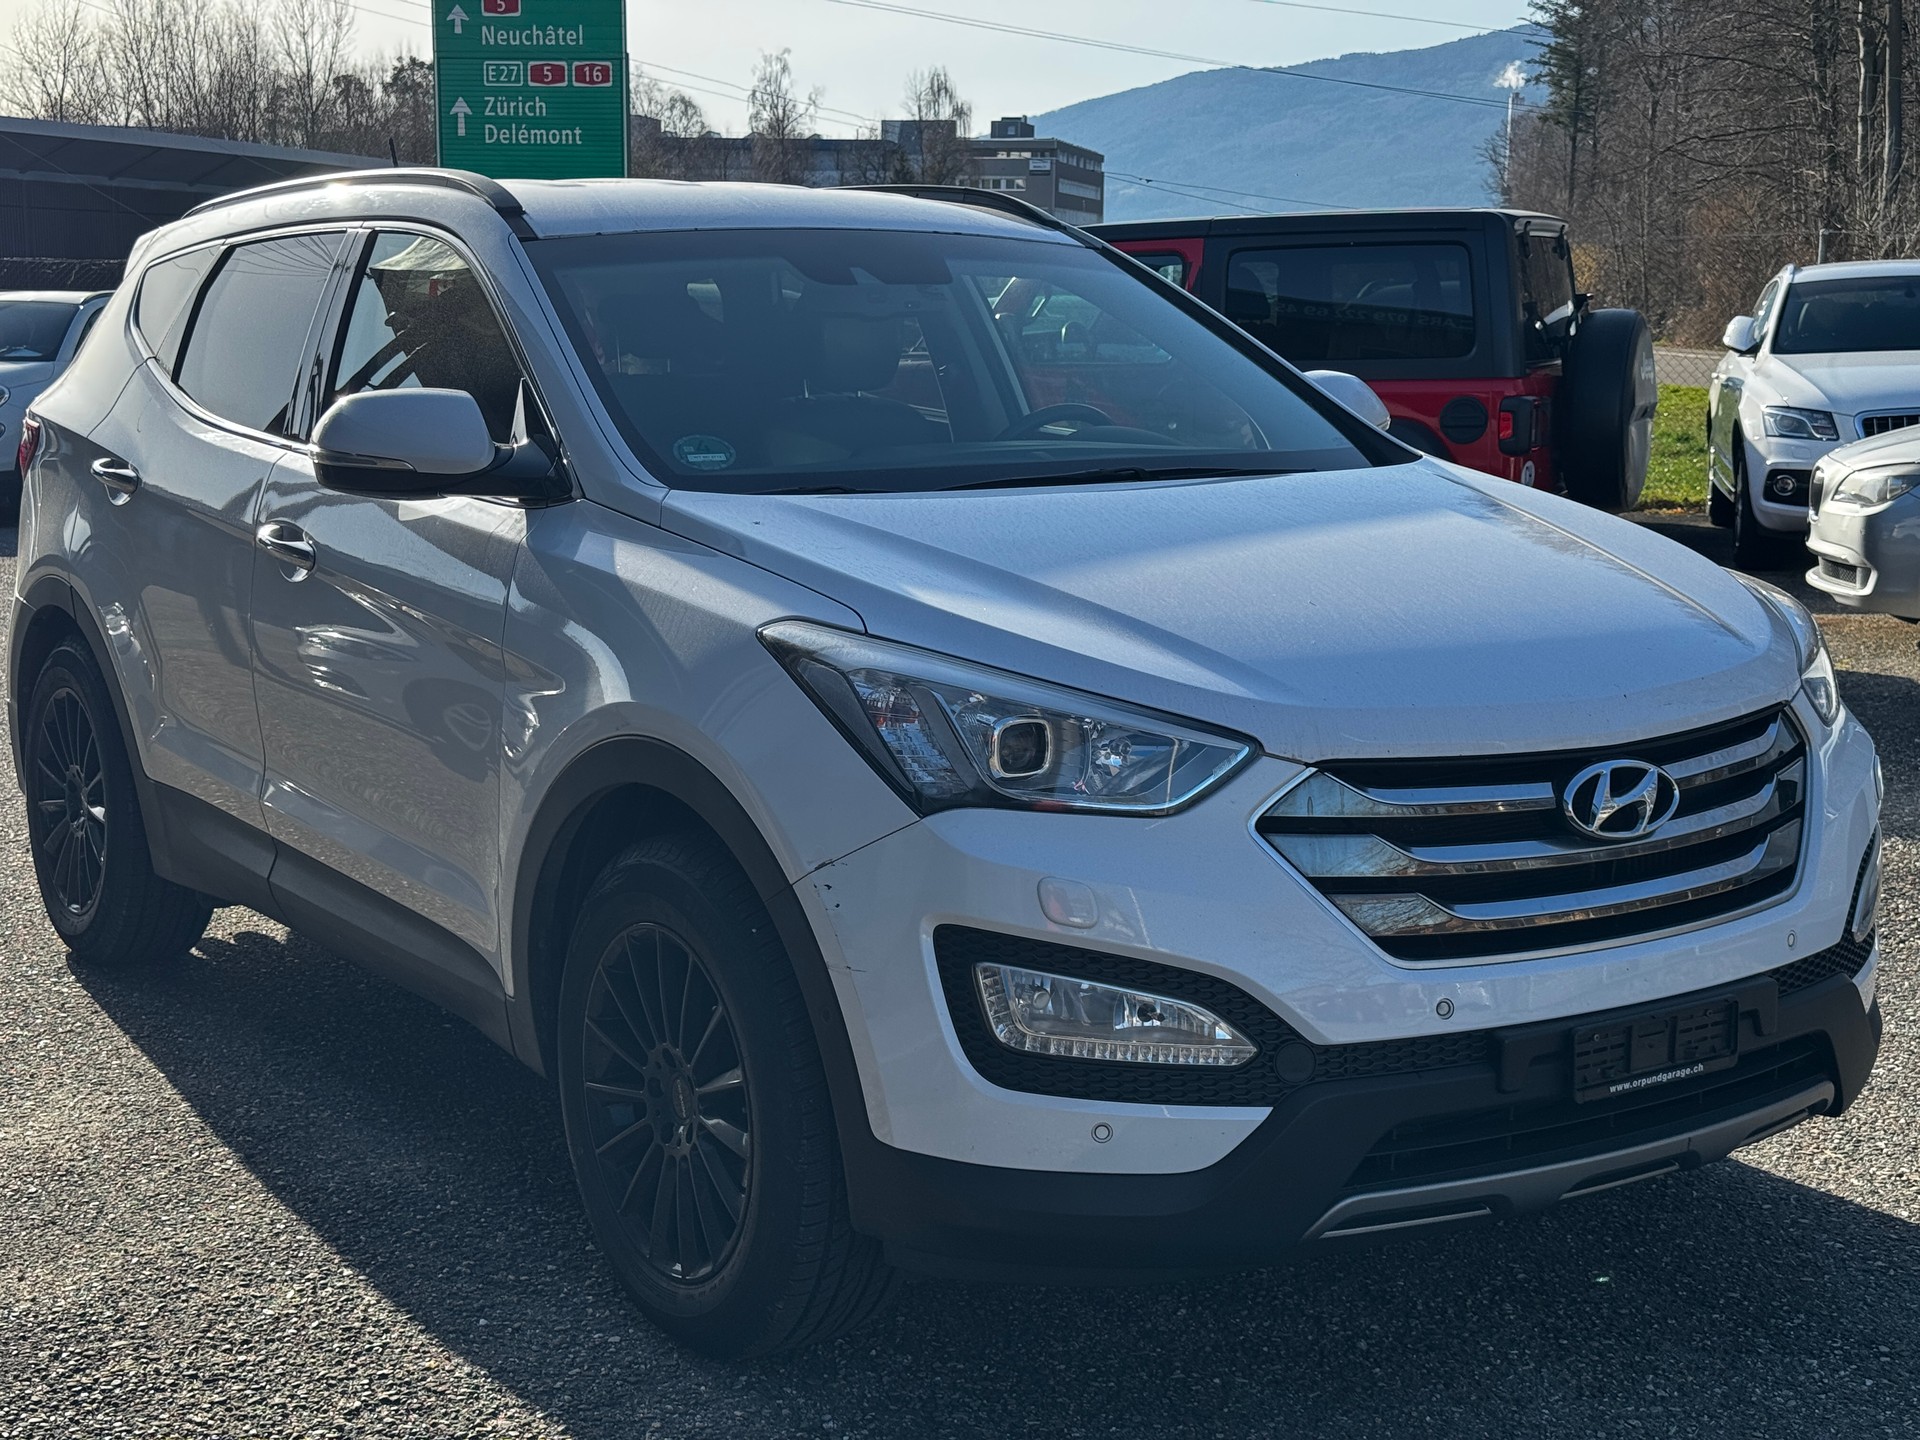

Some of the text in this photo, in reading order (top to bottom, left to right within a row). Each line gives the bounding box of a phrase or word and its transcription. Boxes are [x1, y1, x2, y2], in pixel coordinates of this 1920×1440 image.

[481, 24, 584, 46] Neuchâtel
[543, 66, 553, 82] 5
[583, 66, 603, 82] 16
[484, 96, 547, 117] Zürich
[484, 123, 583, 145] Delémont
[1609, 1063, 1704, 1093] www.orpundgarage.ch
